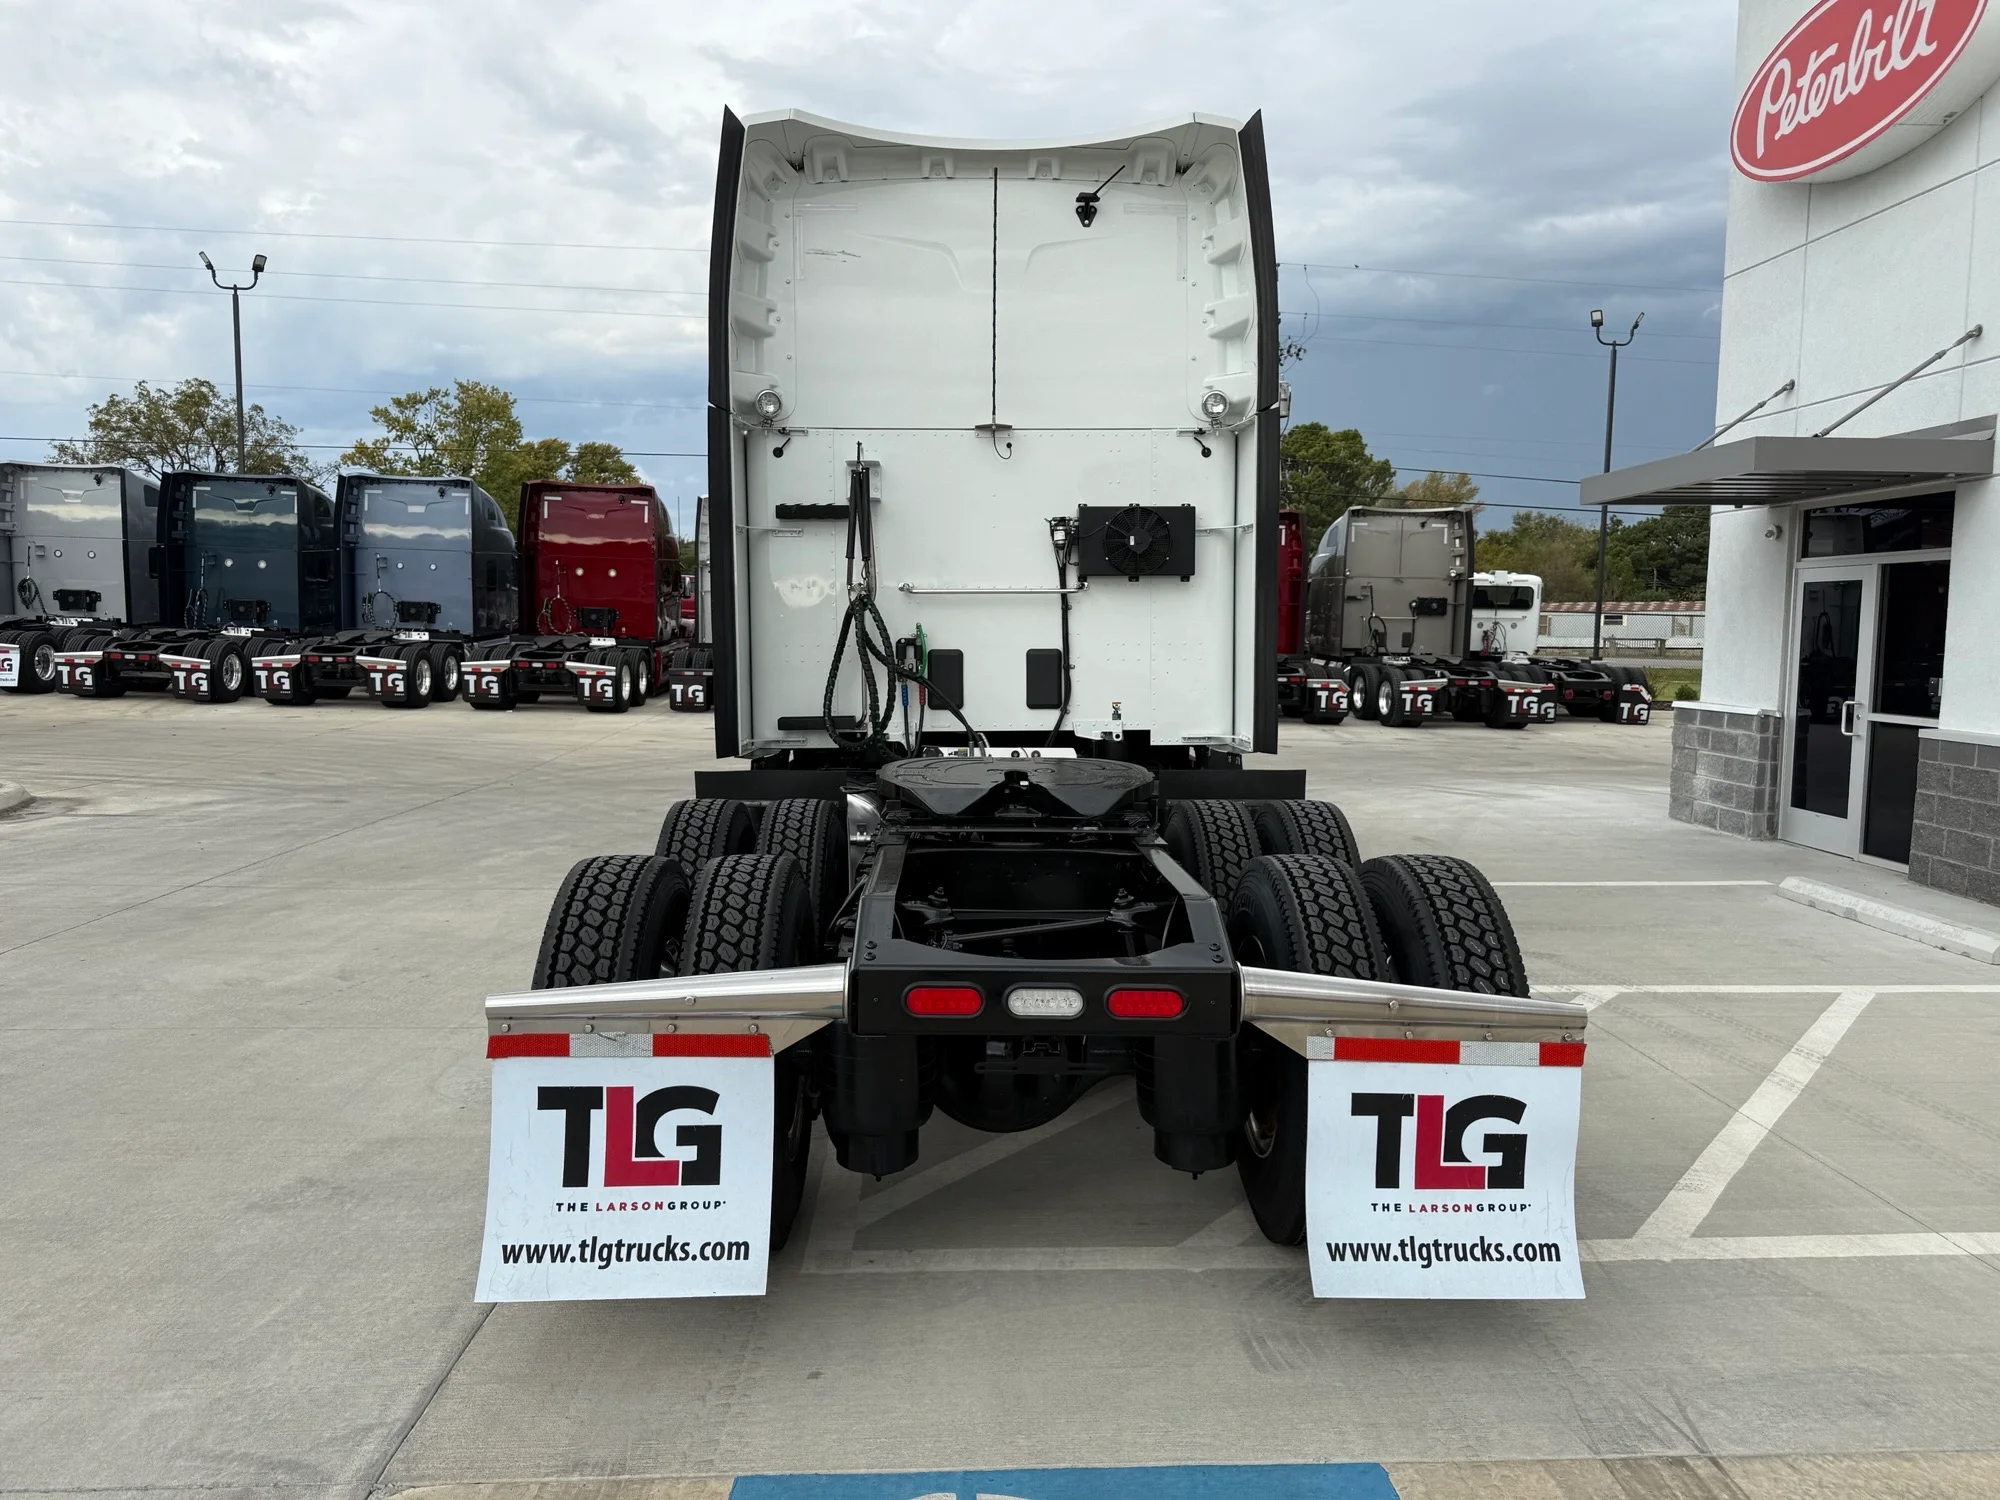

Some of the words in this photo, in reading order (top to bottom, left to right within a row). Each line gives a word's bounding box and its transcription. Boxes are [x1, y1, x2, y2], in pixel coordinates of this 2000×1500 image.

[1756, 0, 1938, 159] Peterbilt
[537, 1085, 723, 1188] TLG
[1351, 1092, 1528, 1190] TLG
[555, 1202, 588, 1213] THE
[1371, 1202, 1402, 1213] THE
[501, 1235, 750, 1270] www.tlgtrucks.com
[1326, 1235, 1562, 1269] www.tlgtrucks.com
